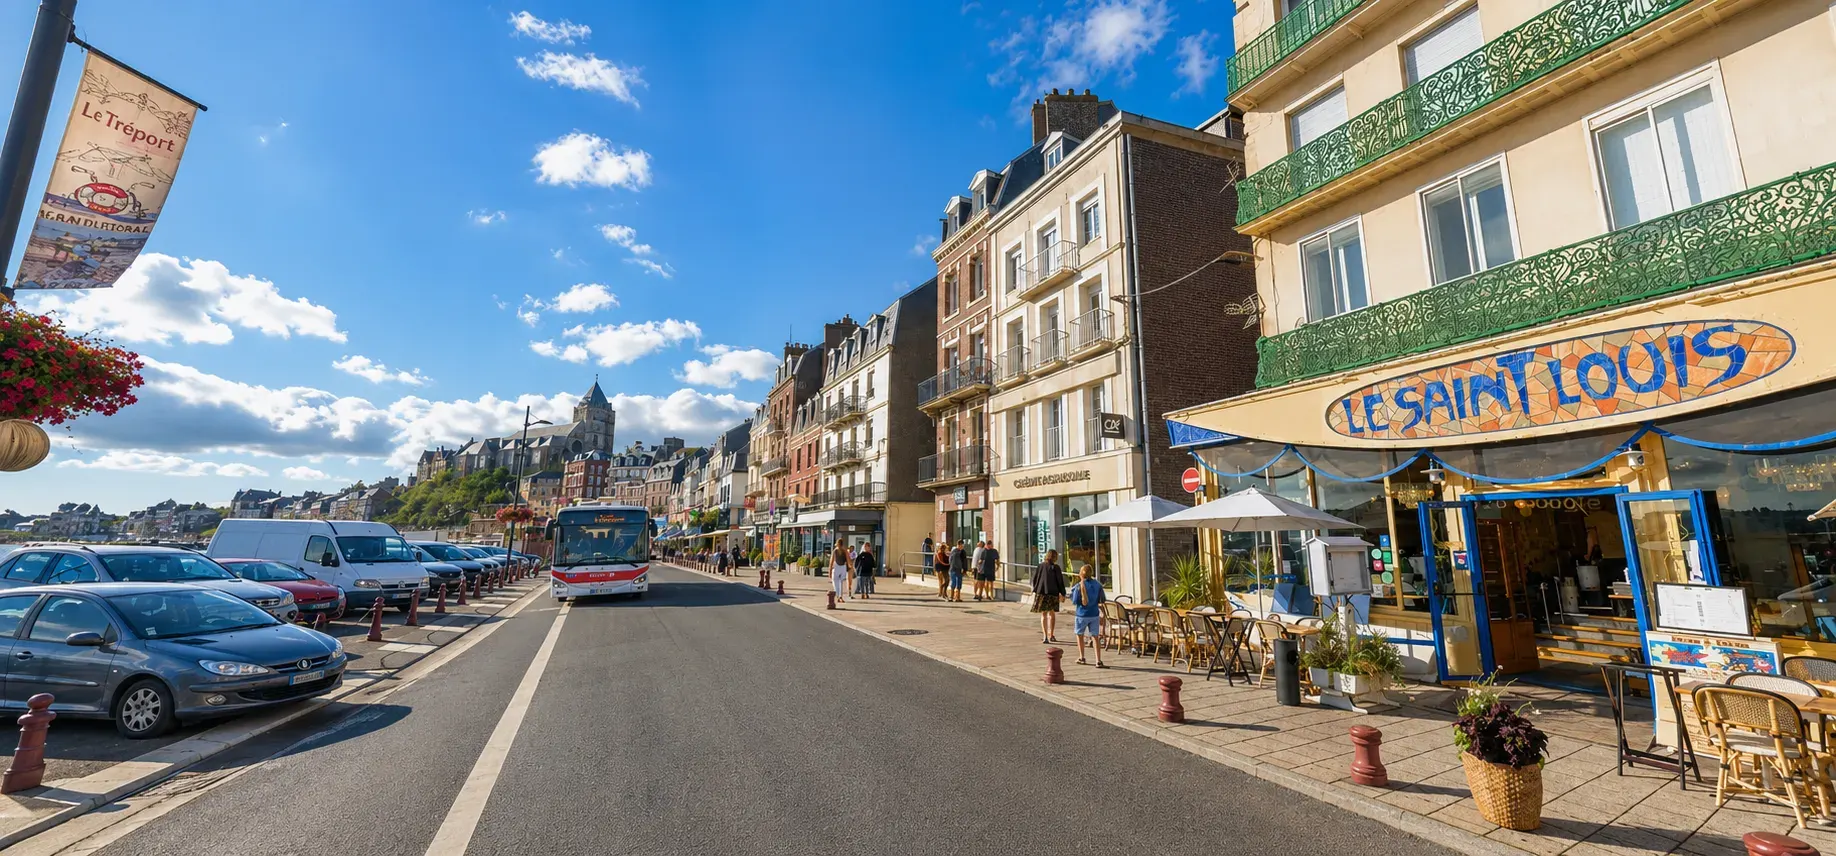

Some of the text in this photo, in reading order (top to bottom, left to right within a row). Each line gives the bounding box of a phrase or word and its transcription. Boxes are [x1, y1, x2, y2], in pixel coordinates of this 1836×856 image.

[81, 102, 175, 152] Le Tréport
[1343, 324, 1747, 434] LE SAINT LOUIS
